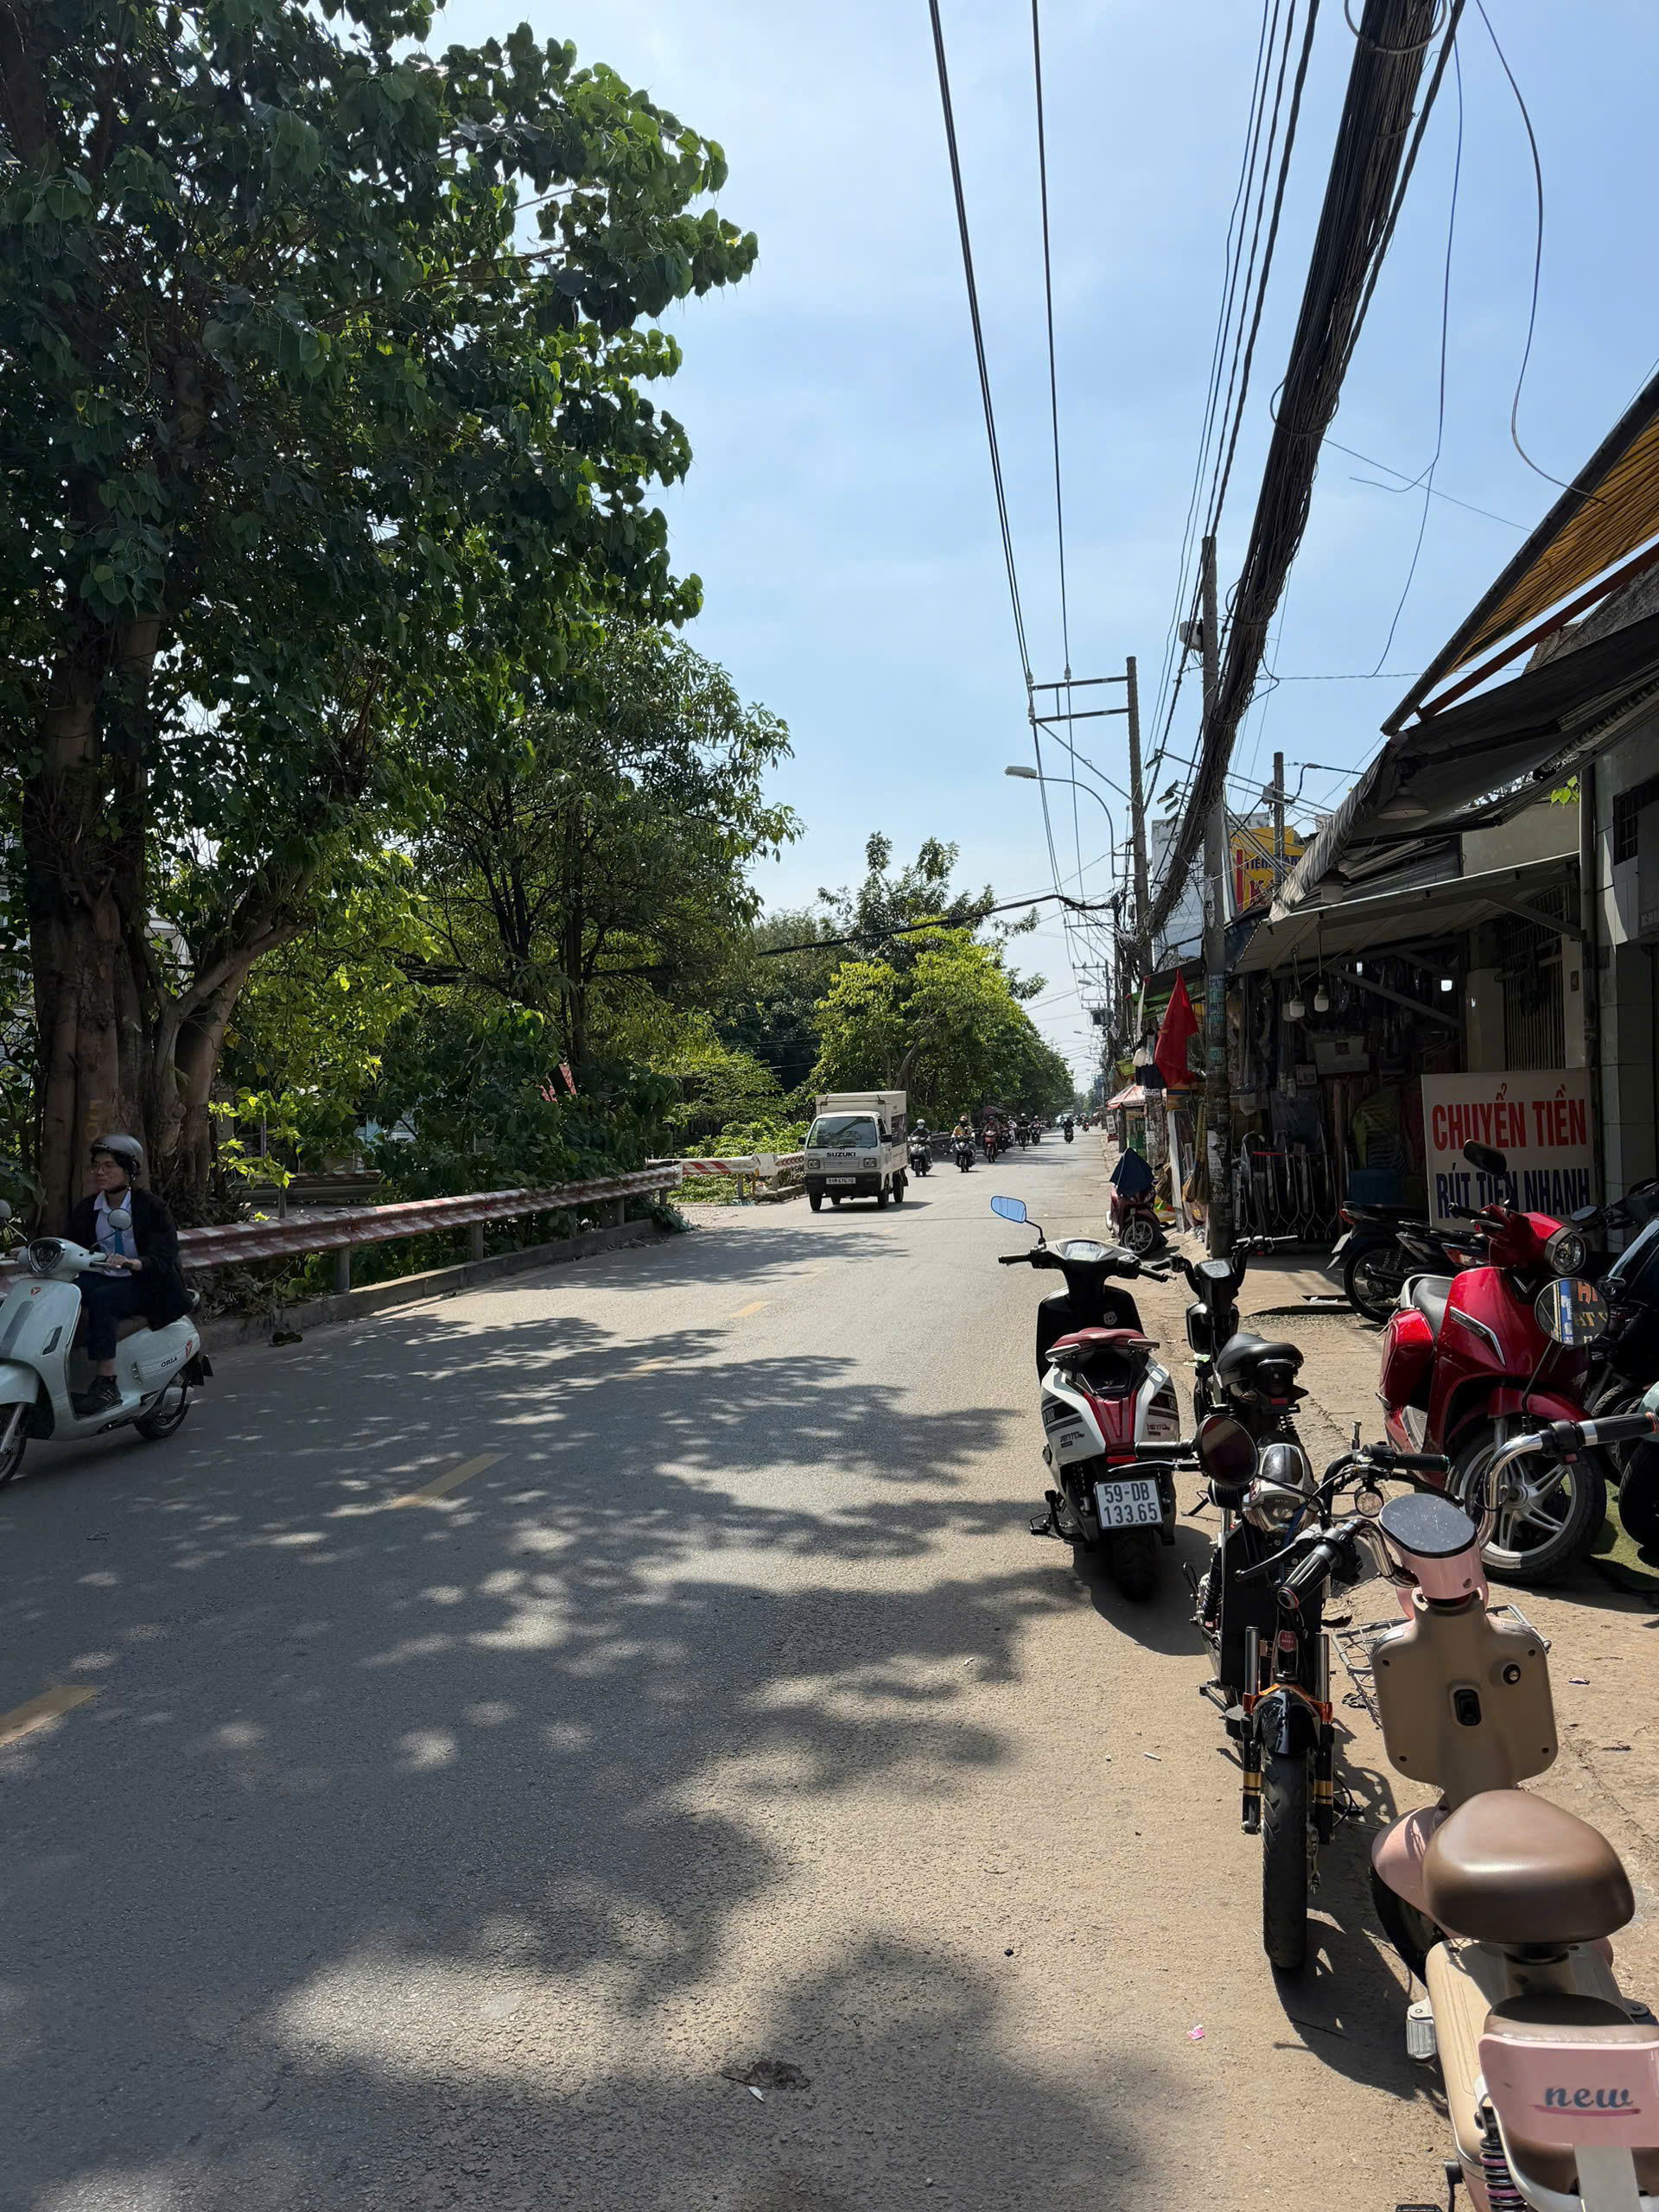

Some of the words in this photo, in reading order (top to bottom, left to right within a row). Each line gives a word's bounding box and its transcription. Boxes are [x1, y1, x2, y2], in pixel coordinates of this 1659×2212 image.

[1432, 1083, 1527, 1151] CHUYỂN
[1532, 1084, 1587, 1147] TIỀN
[1436, 1162, 1471, 1219] RÚT
[1523, 1168, 1591, 1216] NHANH
[1104, 1483, 1150, 1503] 59-DB
[1104, 1503, 1158, 1525] 133.65
[1544, 2088, 1634, 2108] new
